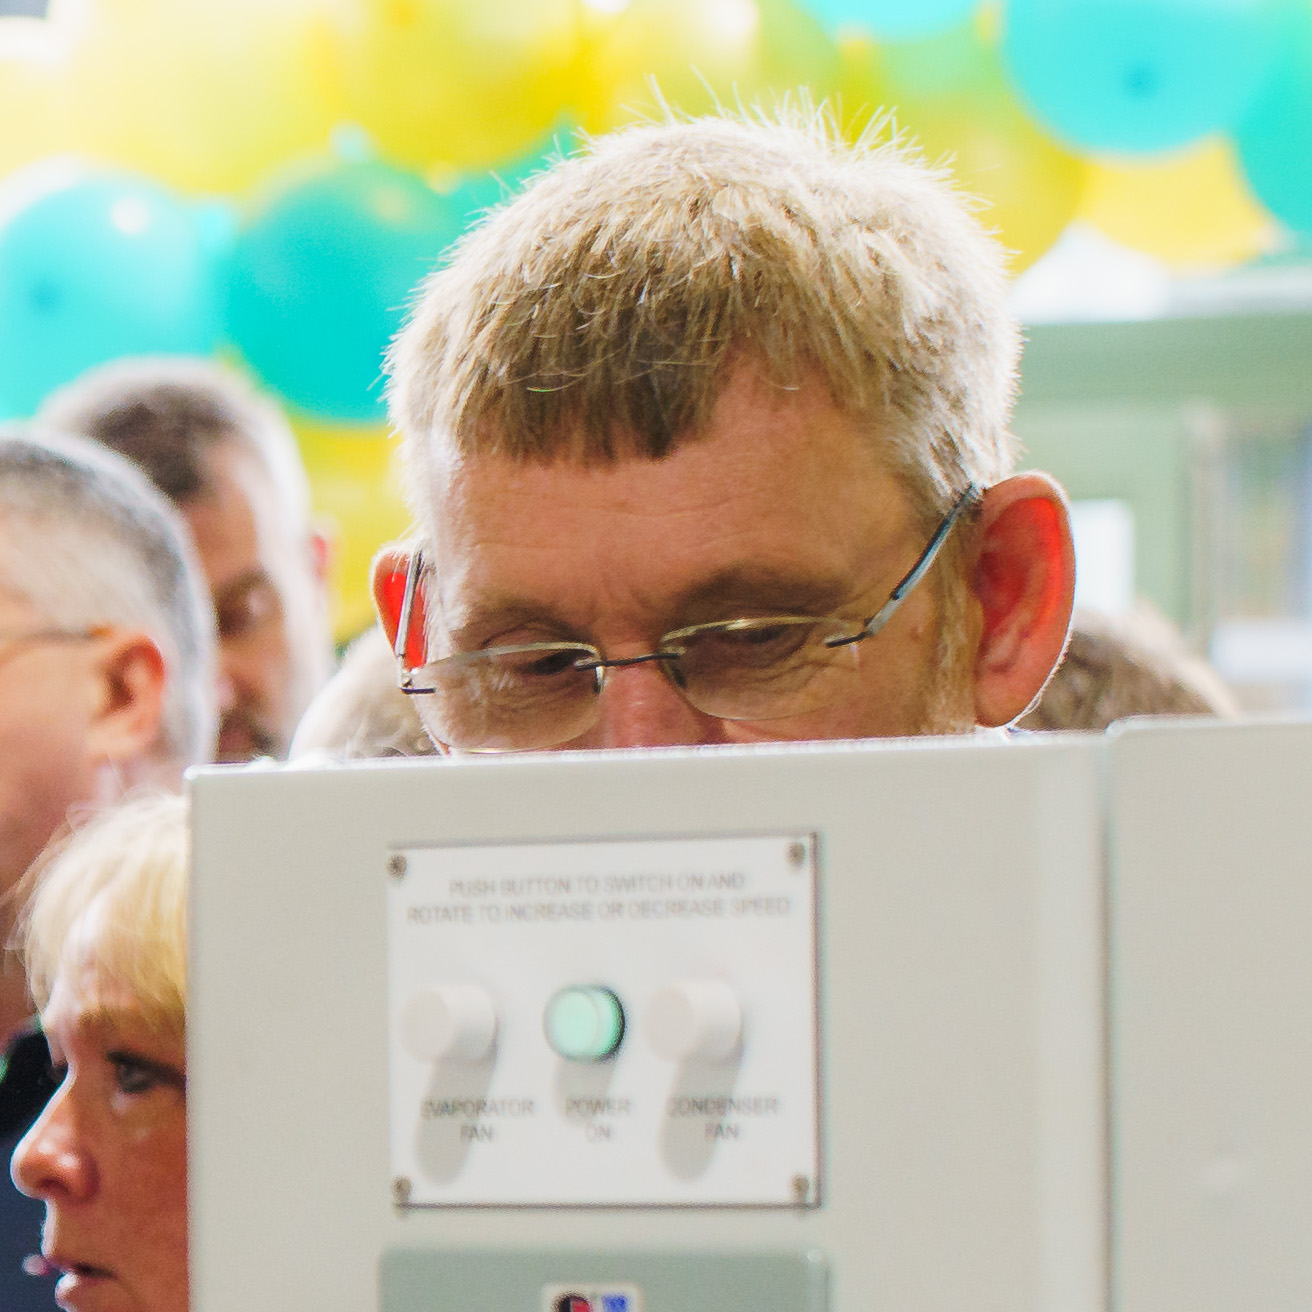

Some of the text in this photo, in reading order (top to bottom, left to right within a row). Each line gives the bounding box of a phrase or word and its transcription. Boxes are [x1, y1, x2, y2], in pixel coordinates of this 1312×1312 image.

[407, 905, 474, 925] ROTATE
[506, 901, 592, 922] INCREASE
[628, 898, 724, 920] DECREASE
[730, 896, 791, 918] SPEED
[565, 1098, 631, 1117] POWER
